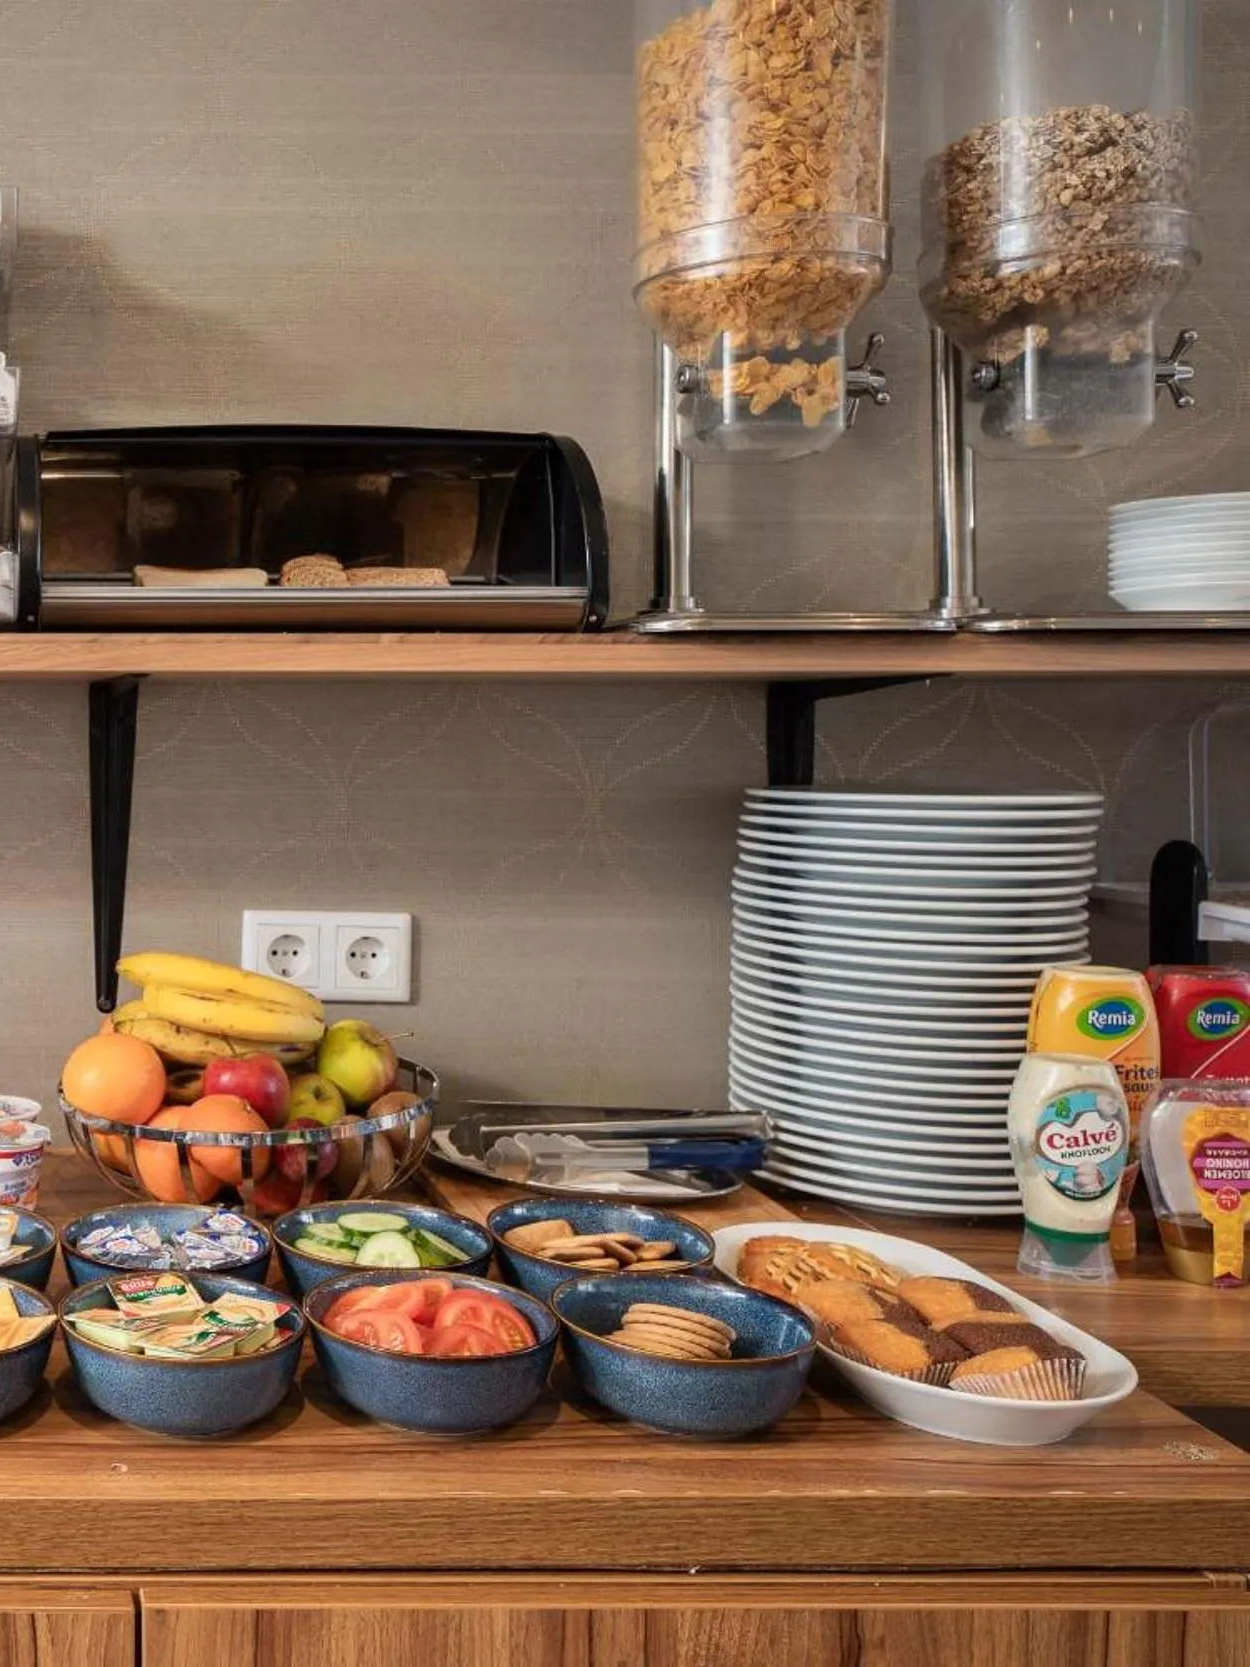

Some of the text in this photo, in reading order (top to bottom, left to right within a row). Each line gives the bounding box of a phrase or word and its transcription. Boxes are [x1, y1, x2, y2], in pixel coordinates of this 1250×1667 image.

[1088, 1010, 1136, 1029] Remia
[1197, 1010, 1240, 1027] Remia
[1047, 1122, 1117, 1149] Calvé
